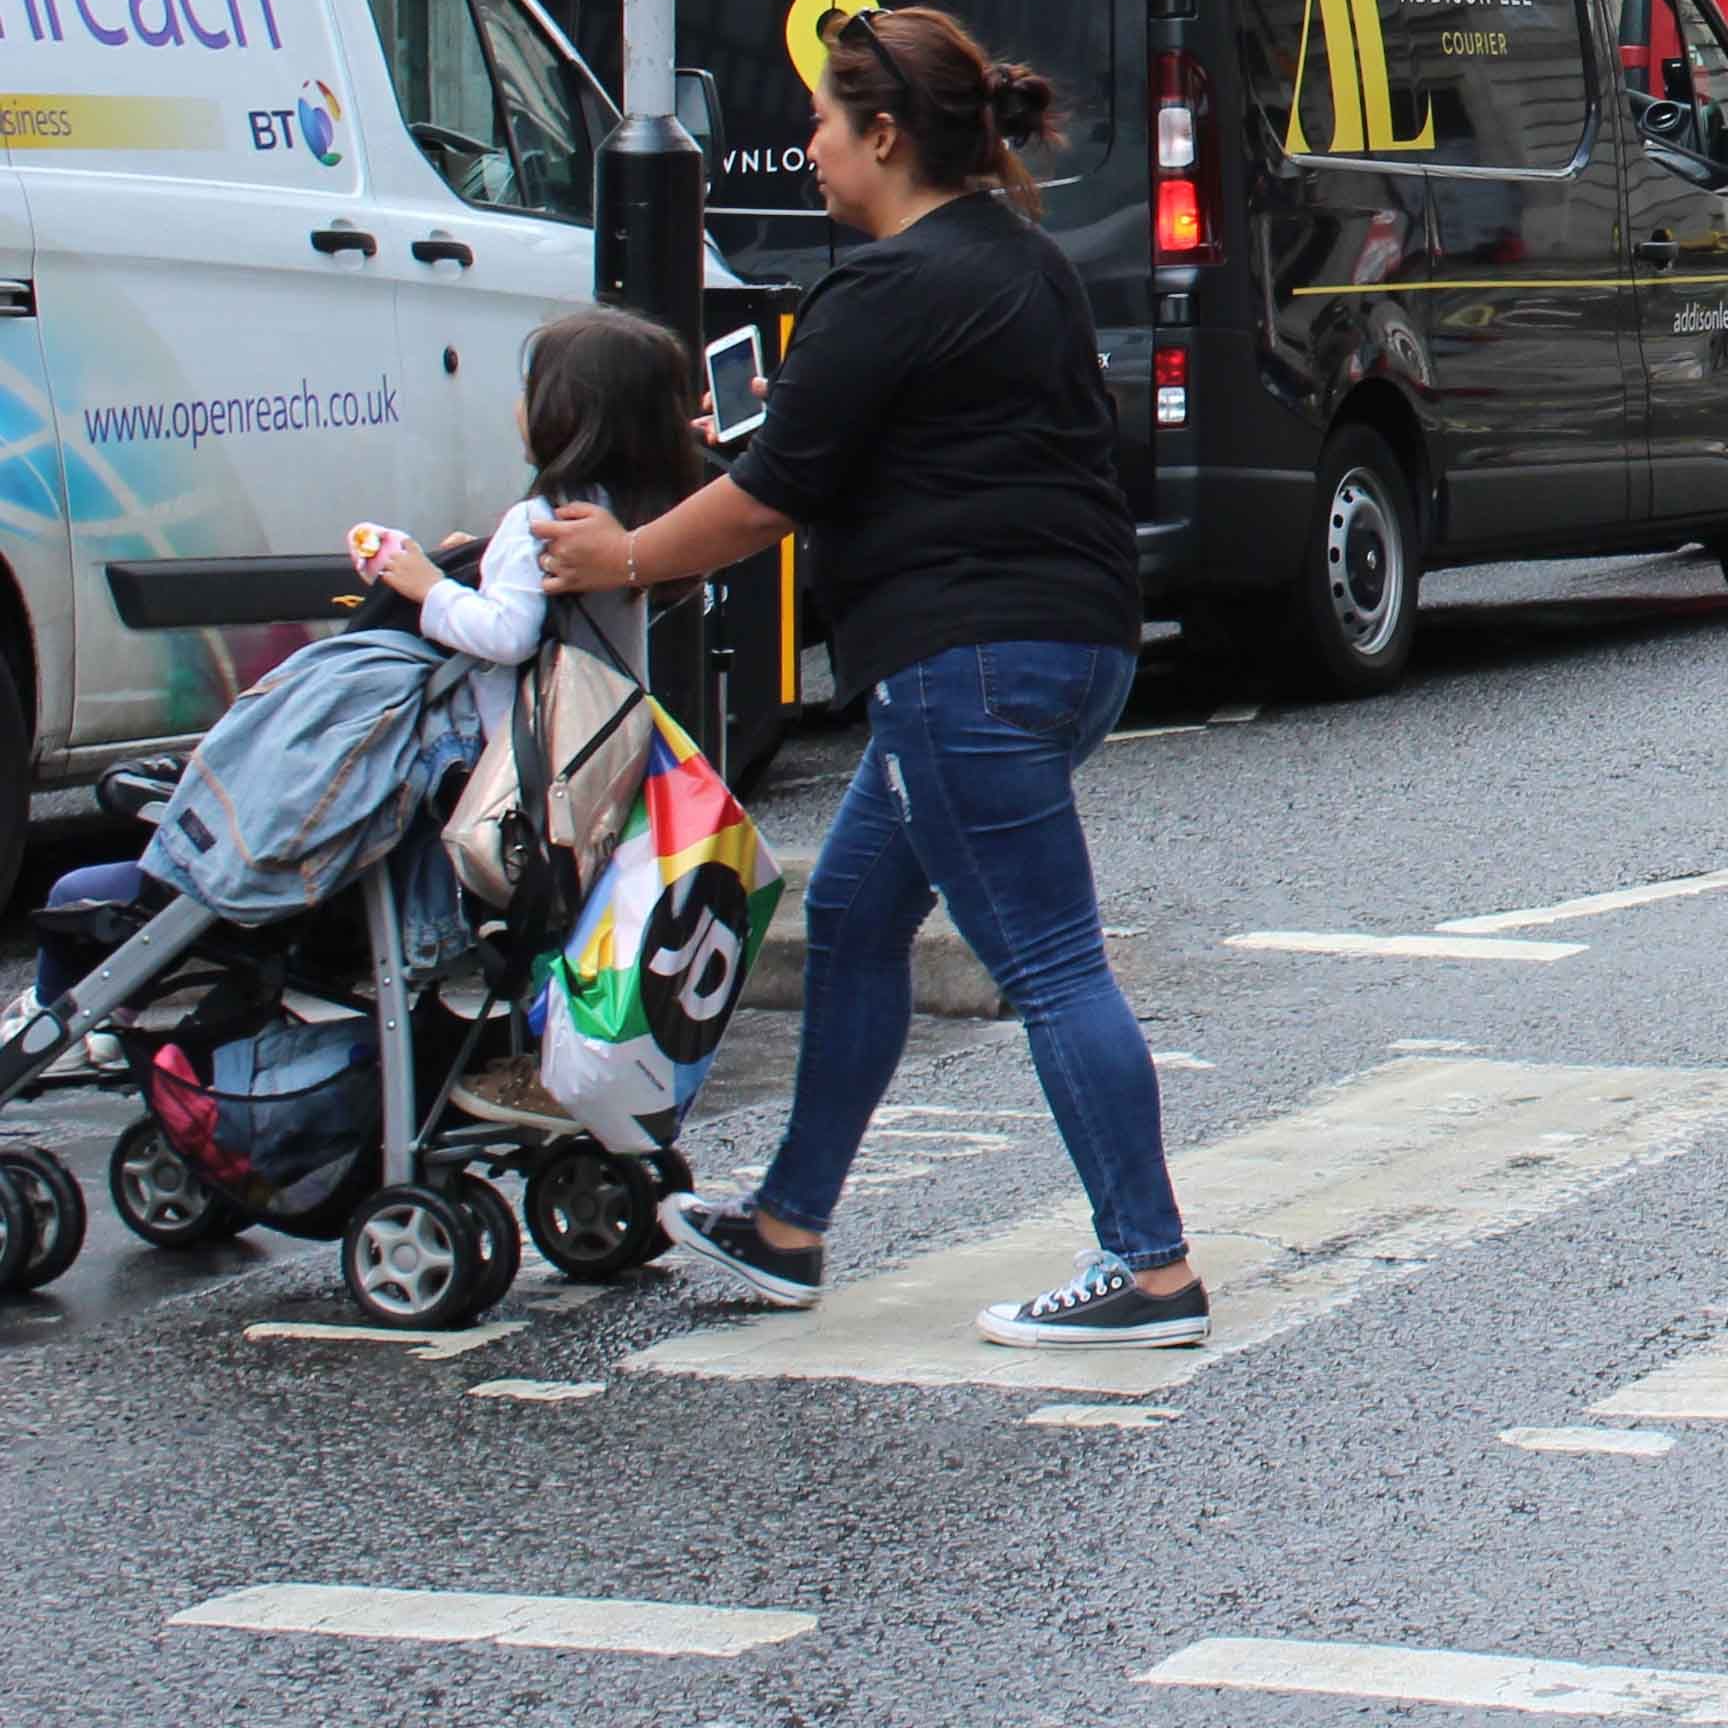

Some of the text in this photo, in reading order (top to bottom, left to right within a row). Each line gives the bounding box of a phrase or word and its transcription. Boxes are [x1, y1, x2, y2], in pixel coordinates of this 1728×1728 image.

[1442, 32, 1507, 55] COURIER
[248, 110, 296, 150] BT
[84, 373, 400, 449] www.openreach.co.uk
